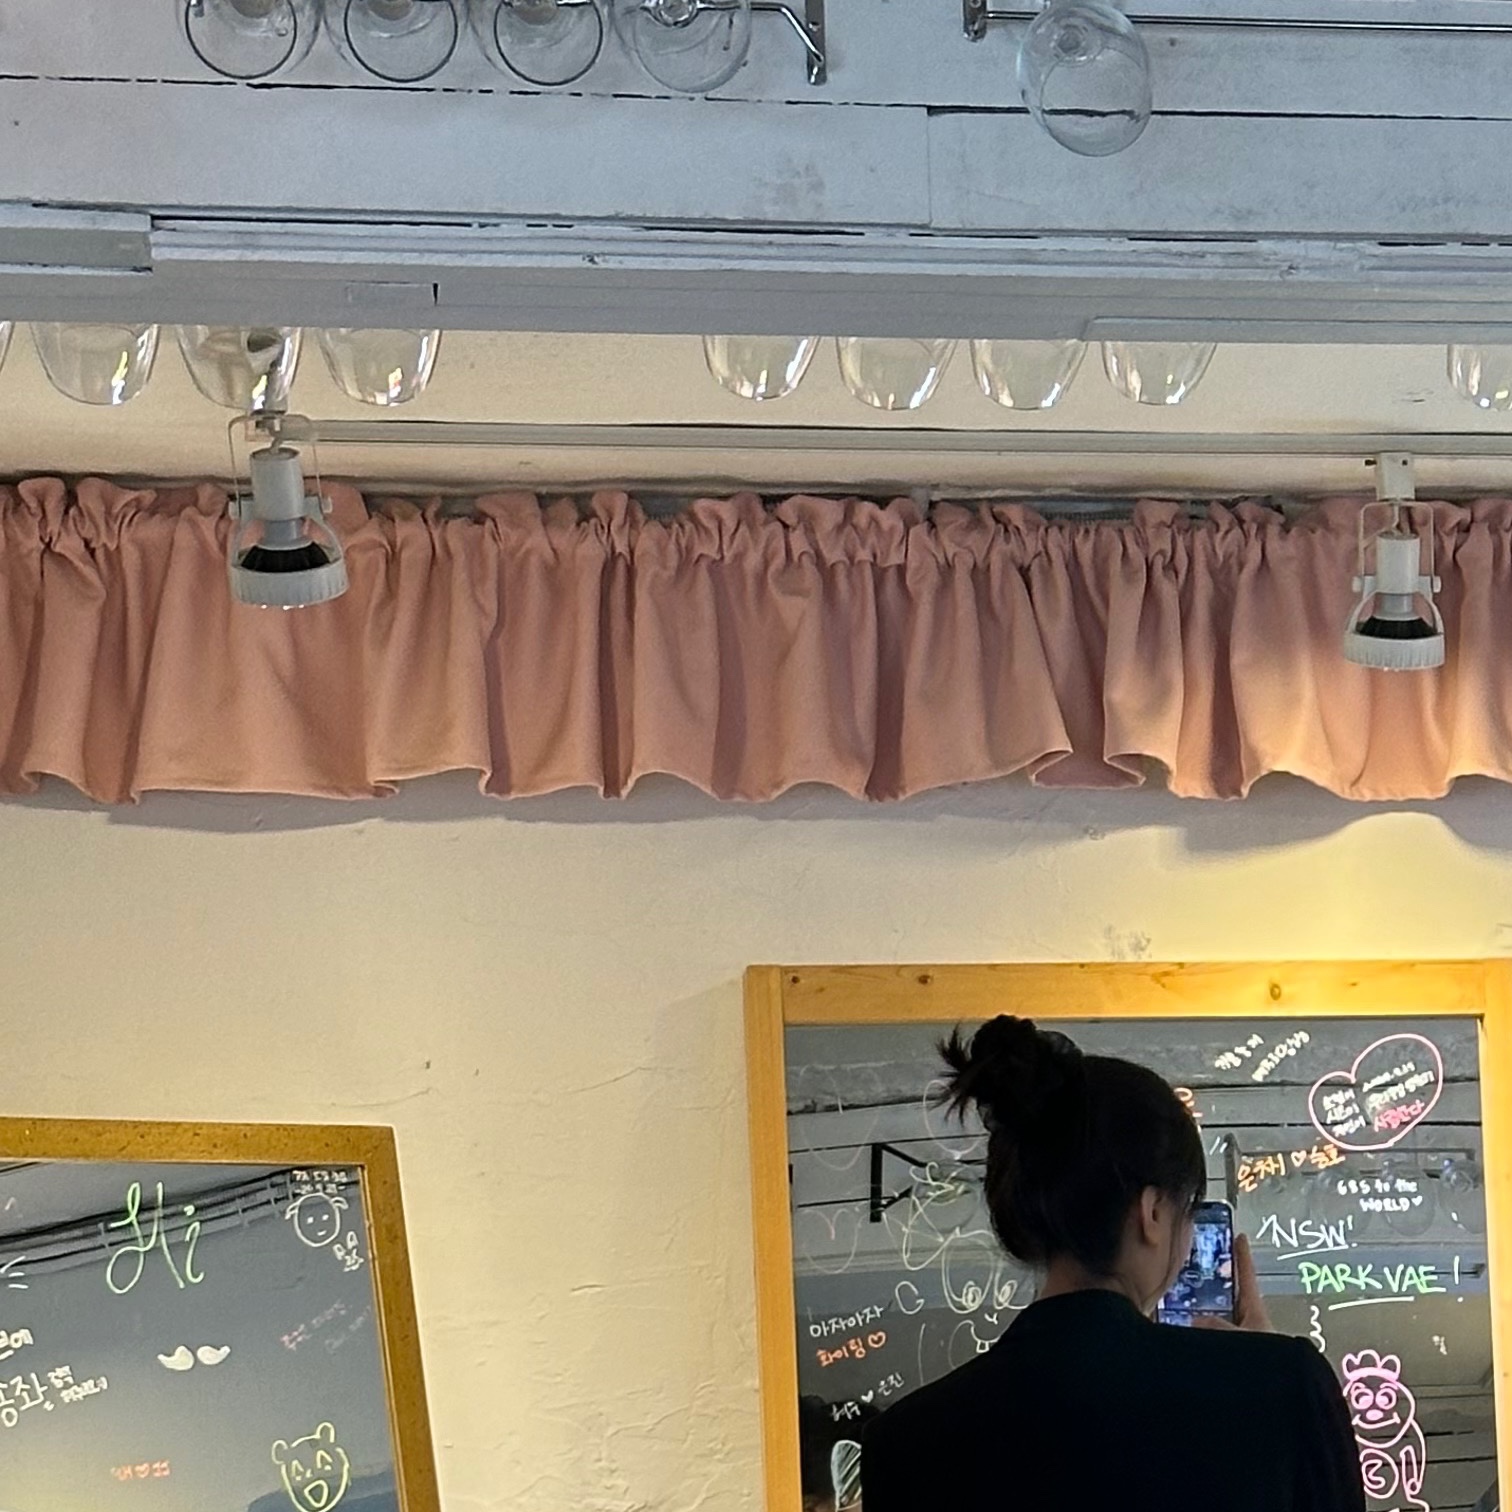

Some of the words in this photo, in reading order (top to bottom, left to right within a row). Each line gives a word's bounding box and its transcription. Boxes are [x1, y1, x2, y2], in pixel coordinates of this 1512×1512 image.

[1358, 1197, 1411, 1213] WORLD
[1298, 1261, 1383, 1294] PARK
[809, 1304, 884, 1338] 아자아자
